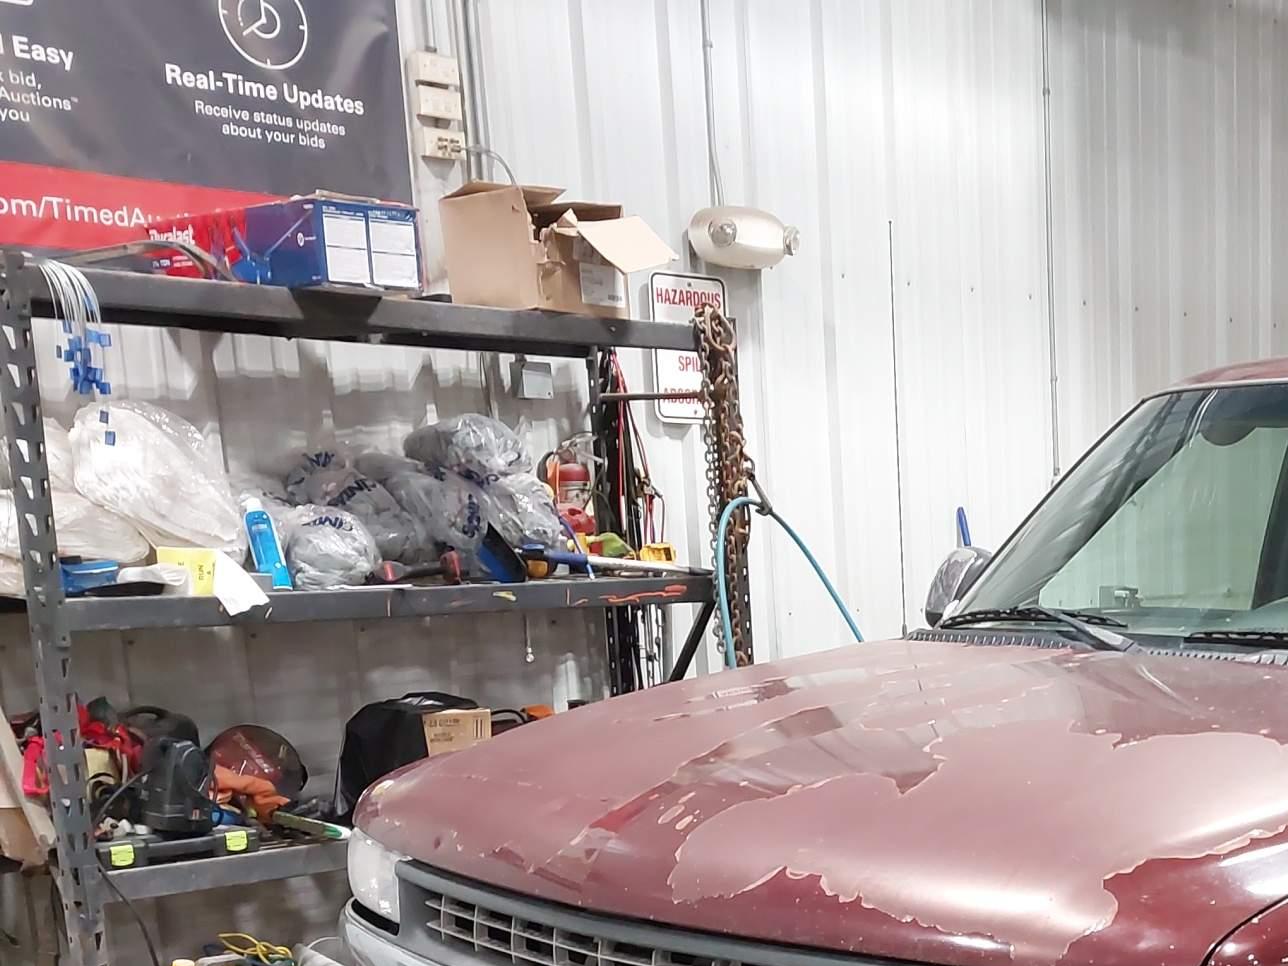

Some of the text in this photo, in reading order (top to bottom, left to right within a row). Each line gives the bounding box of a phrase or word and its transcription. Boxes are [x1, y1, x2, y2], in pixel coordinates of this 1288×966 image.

[12, 34, 74, 72] Easy
[9, 69, 42, 90] bid,
[164, 63, 365, 115] Real-Time Updates
[0, 108, 30, 122] you
[194, 100, 346, 136] Receive status updates
[222, 123, 326, 149] about your bids
[655, 287, 721, 310] HAZARDOUS
